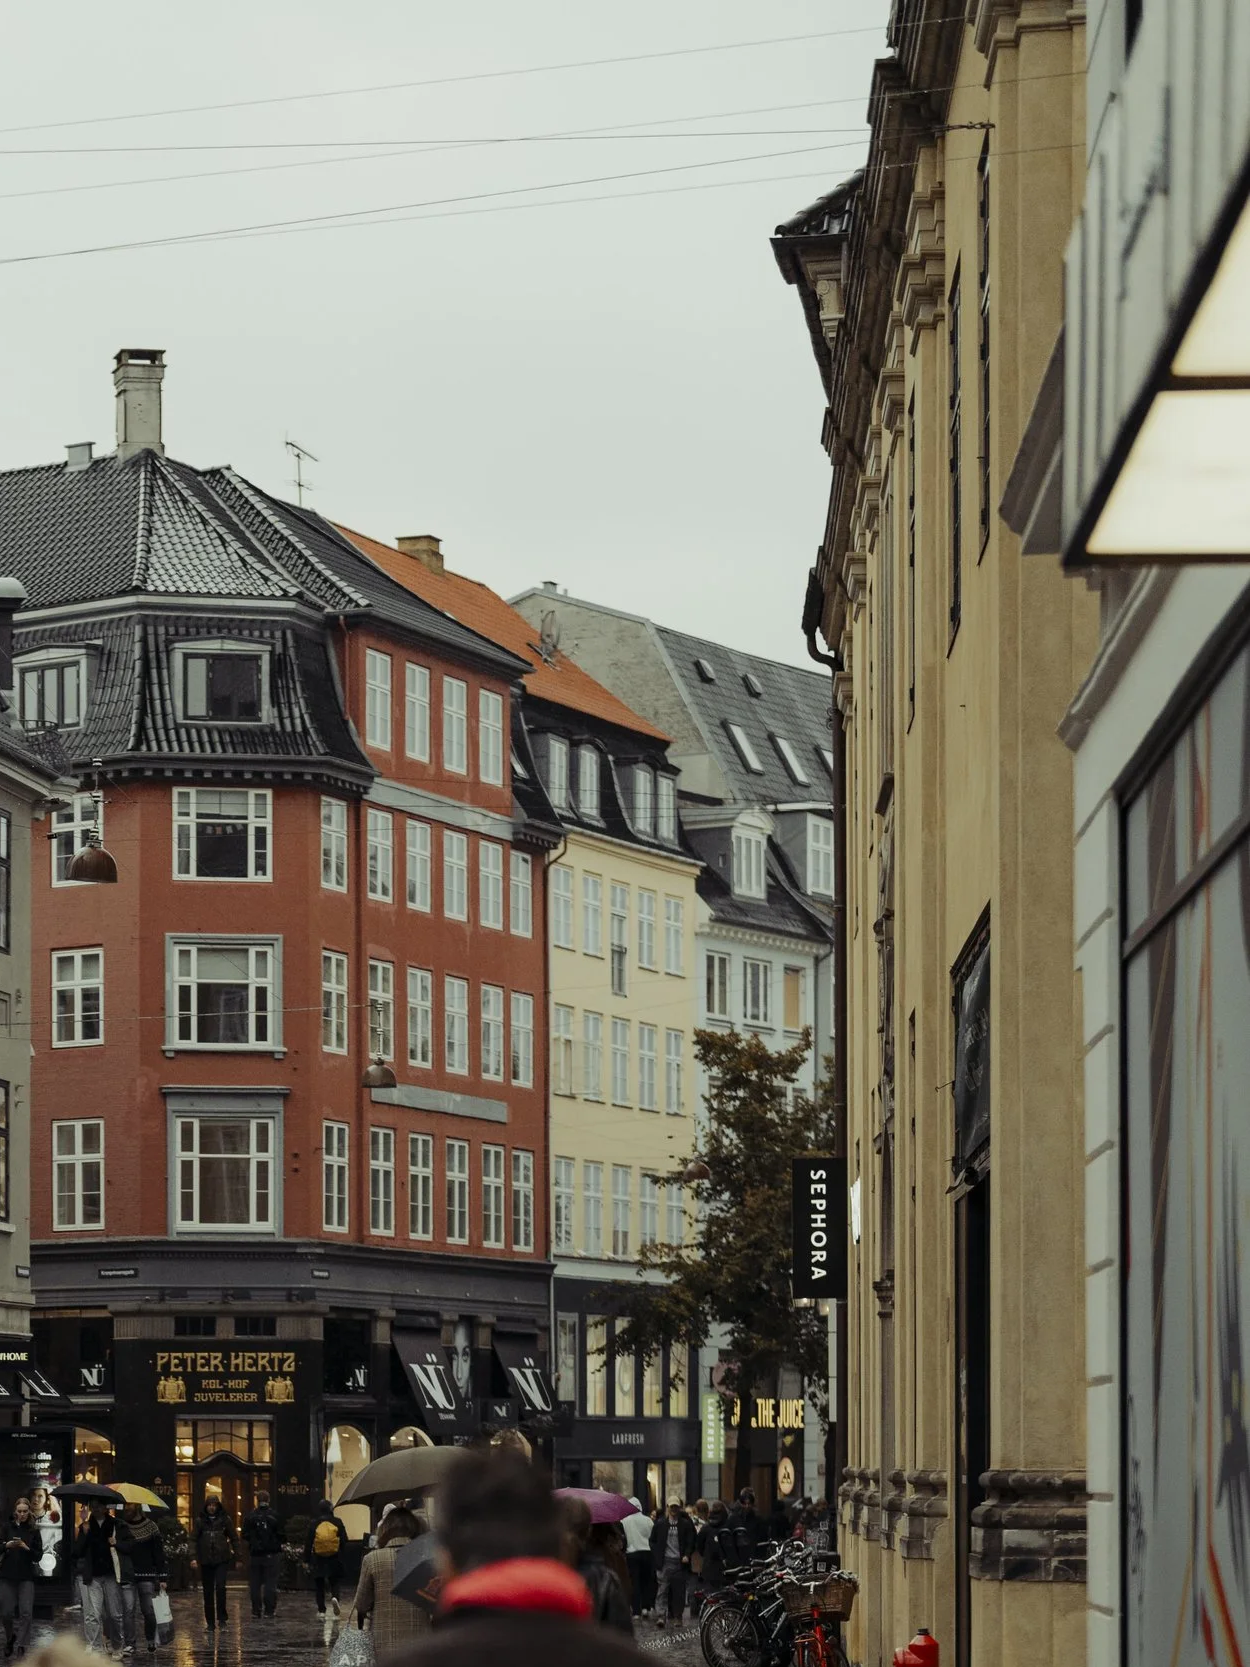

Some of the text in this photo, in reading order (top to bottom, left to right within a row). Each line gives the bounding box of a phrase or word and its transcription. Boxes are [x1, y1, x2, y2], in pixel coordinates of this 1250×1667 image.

[810, 1169, 827, 1280] SEPHORA
[80, 1363, 106, 1387] NÜ
[156, 1352, 295, 1372] PETER HERTZ
[408, 1353, 456, 1410] NÜ
[507, 1356, 553, 1412] NÜ
[193, 1392, 259, 1402] JUVELERER
[756, 1398, 776, 1428] THE
[777, 1398, 805, 1428] JUICE
[612, 1433, 645, 1445] LABFRESH
